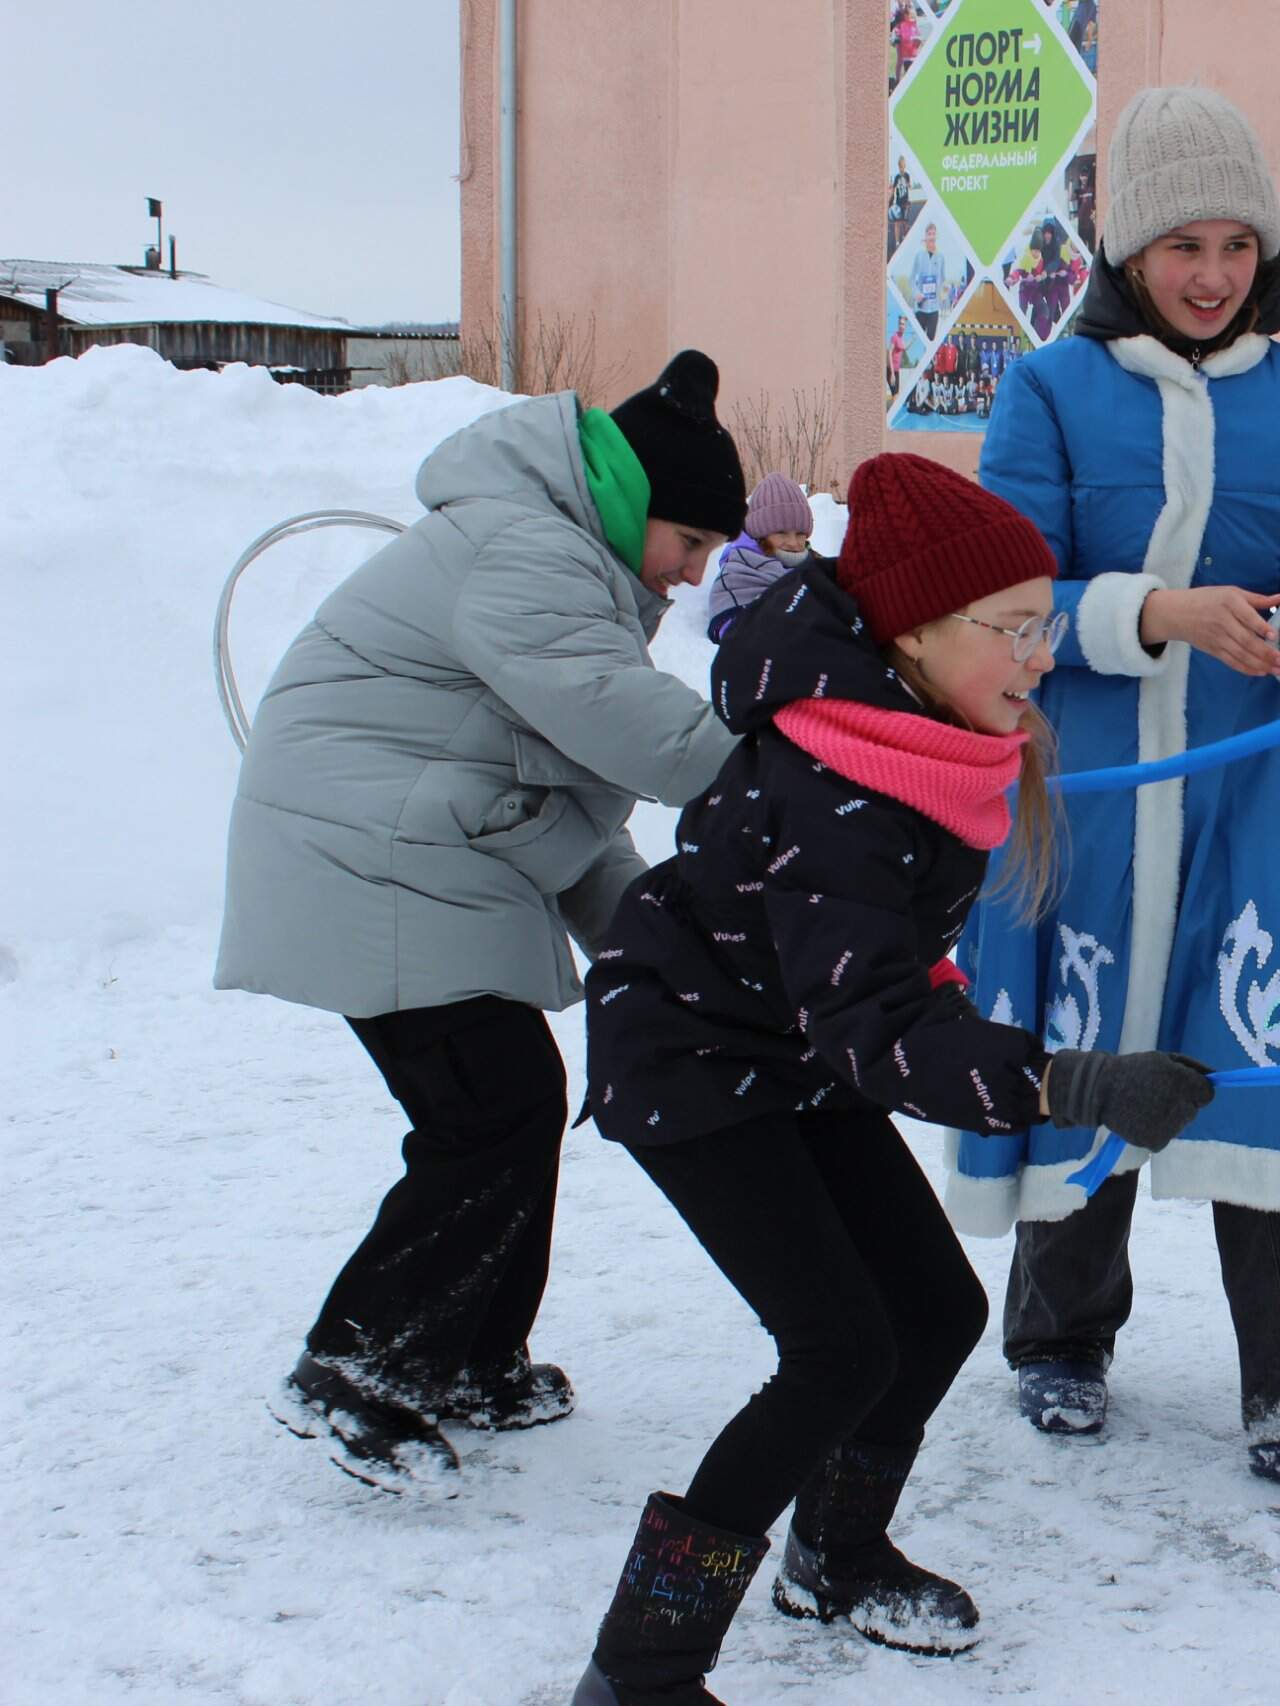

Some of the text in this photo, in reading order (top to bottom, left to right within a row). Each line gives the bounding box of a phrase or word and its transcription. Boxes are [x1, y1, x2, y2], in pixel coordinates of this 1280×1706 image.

[946, 28, 1023, 68] СПОРТ
[945, 67, 1040, 108] НОРМА
[944, 108, 1039, 147] ЖИЗНИ
[941, 147, 1037, 172] ФЕДЕРАЛЬНЫЙ
[941, 175, 989, 192] ПРОЕКТ
[754, 658, 772, 700] Vulpes
[767, 845, 800, 874] Vulpes
[969, 1068, 994, 1111] Vulpes
